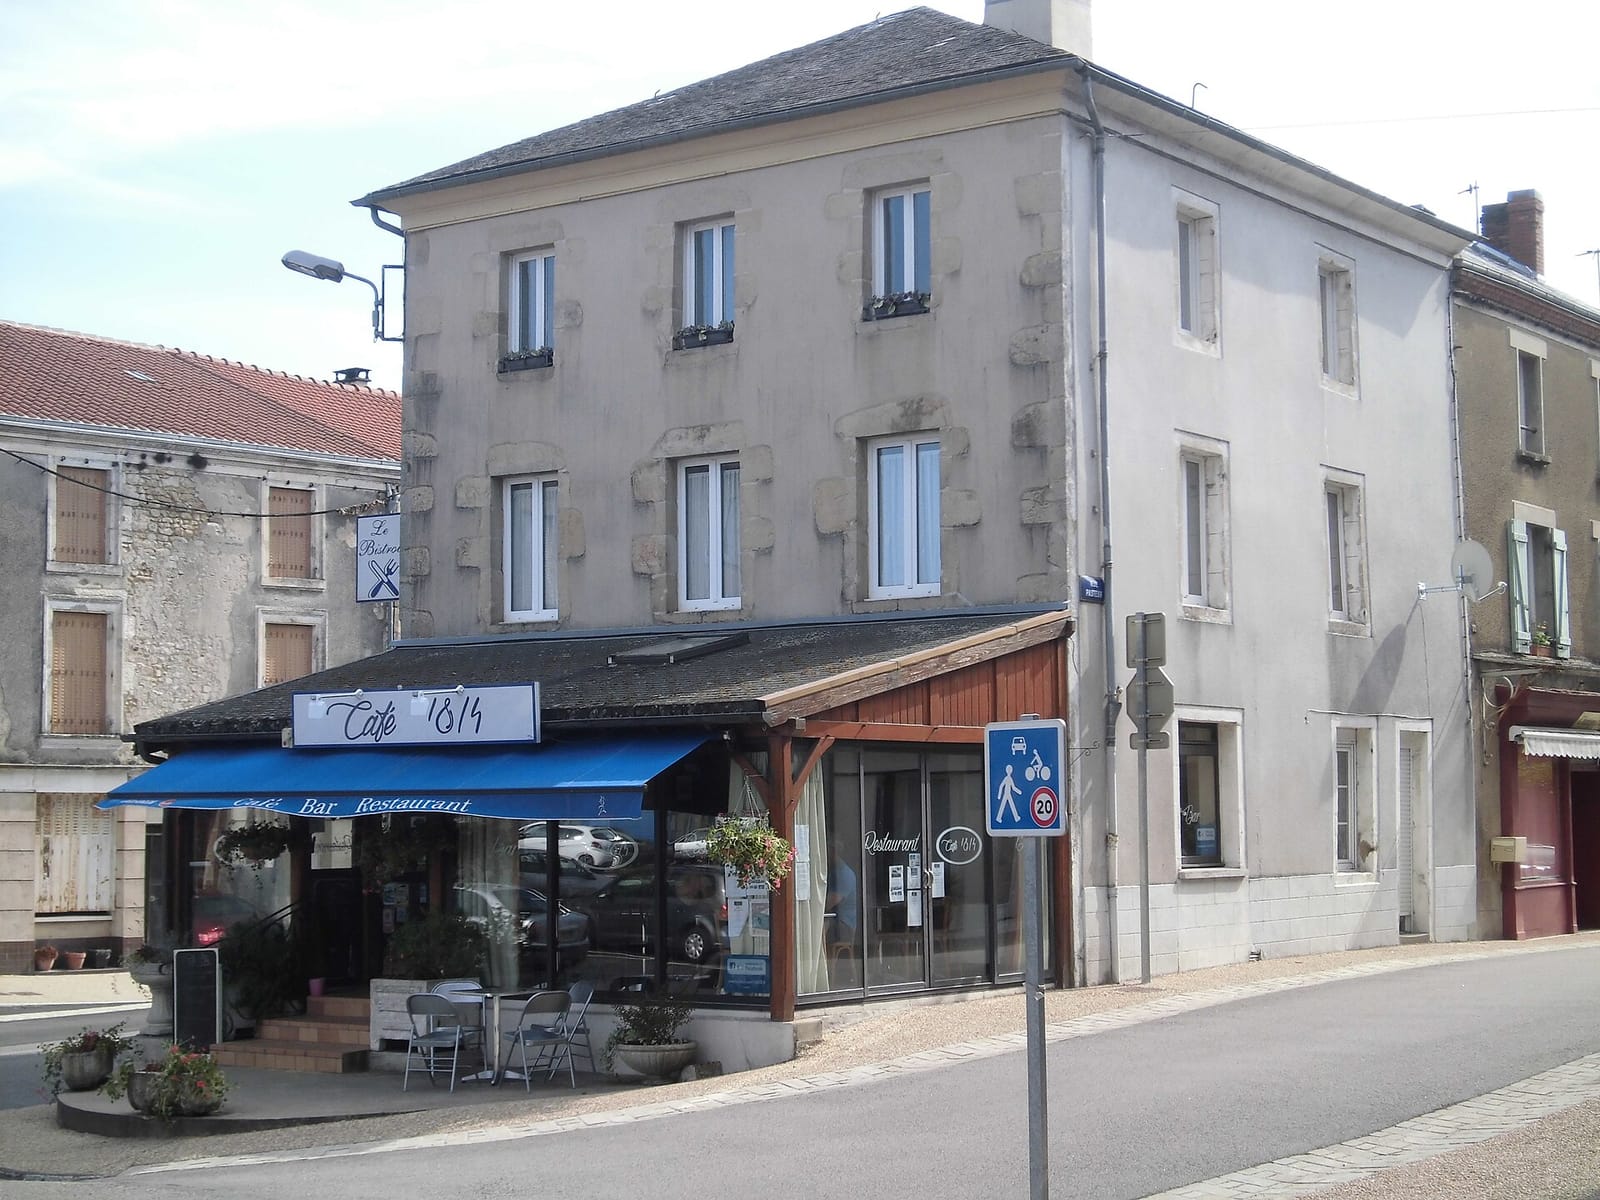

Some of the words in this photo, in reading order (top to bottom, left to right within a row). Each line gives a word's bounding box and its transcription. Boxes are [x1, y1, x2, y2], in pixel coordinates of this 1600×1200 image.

[371, 519, 388, 536] Le
[326, 700, 397, 742] Café
[428, 696, 482, 734] 1814
[233, 797, 283, 808] Café
[299, 798, 338, 815] Bar
[354, 797, 472, 813] Restaurant
[1036, 800, 1053, 815] 20
[864, 830, 921, 856] Restaurant
